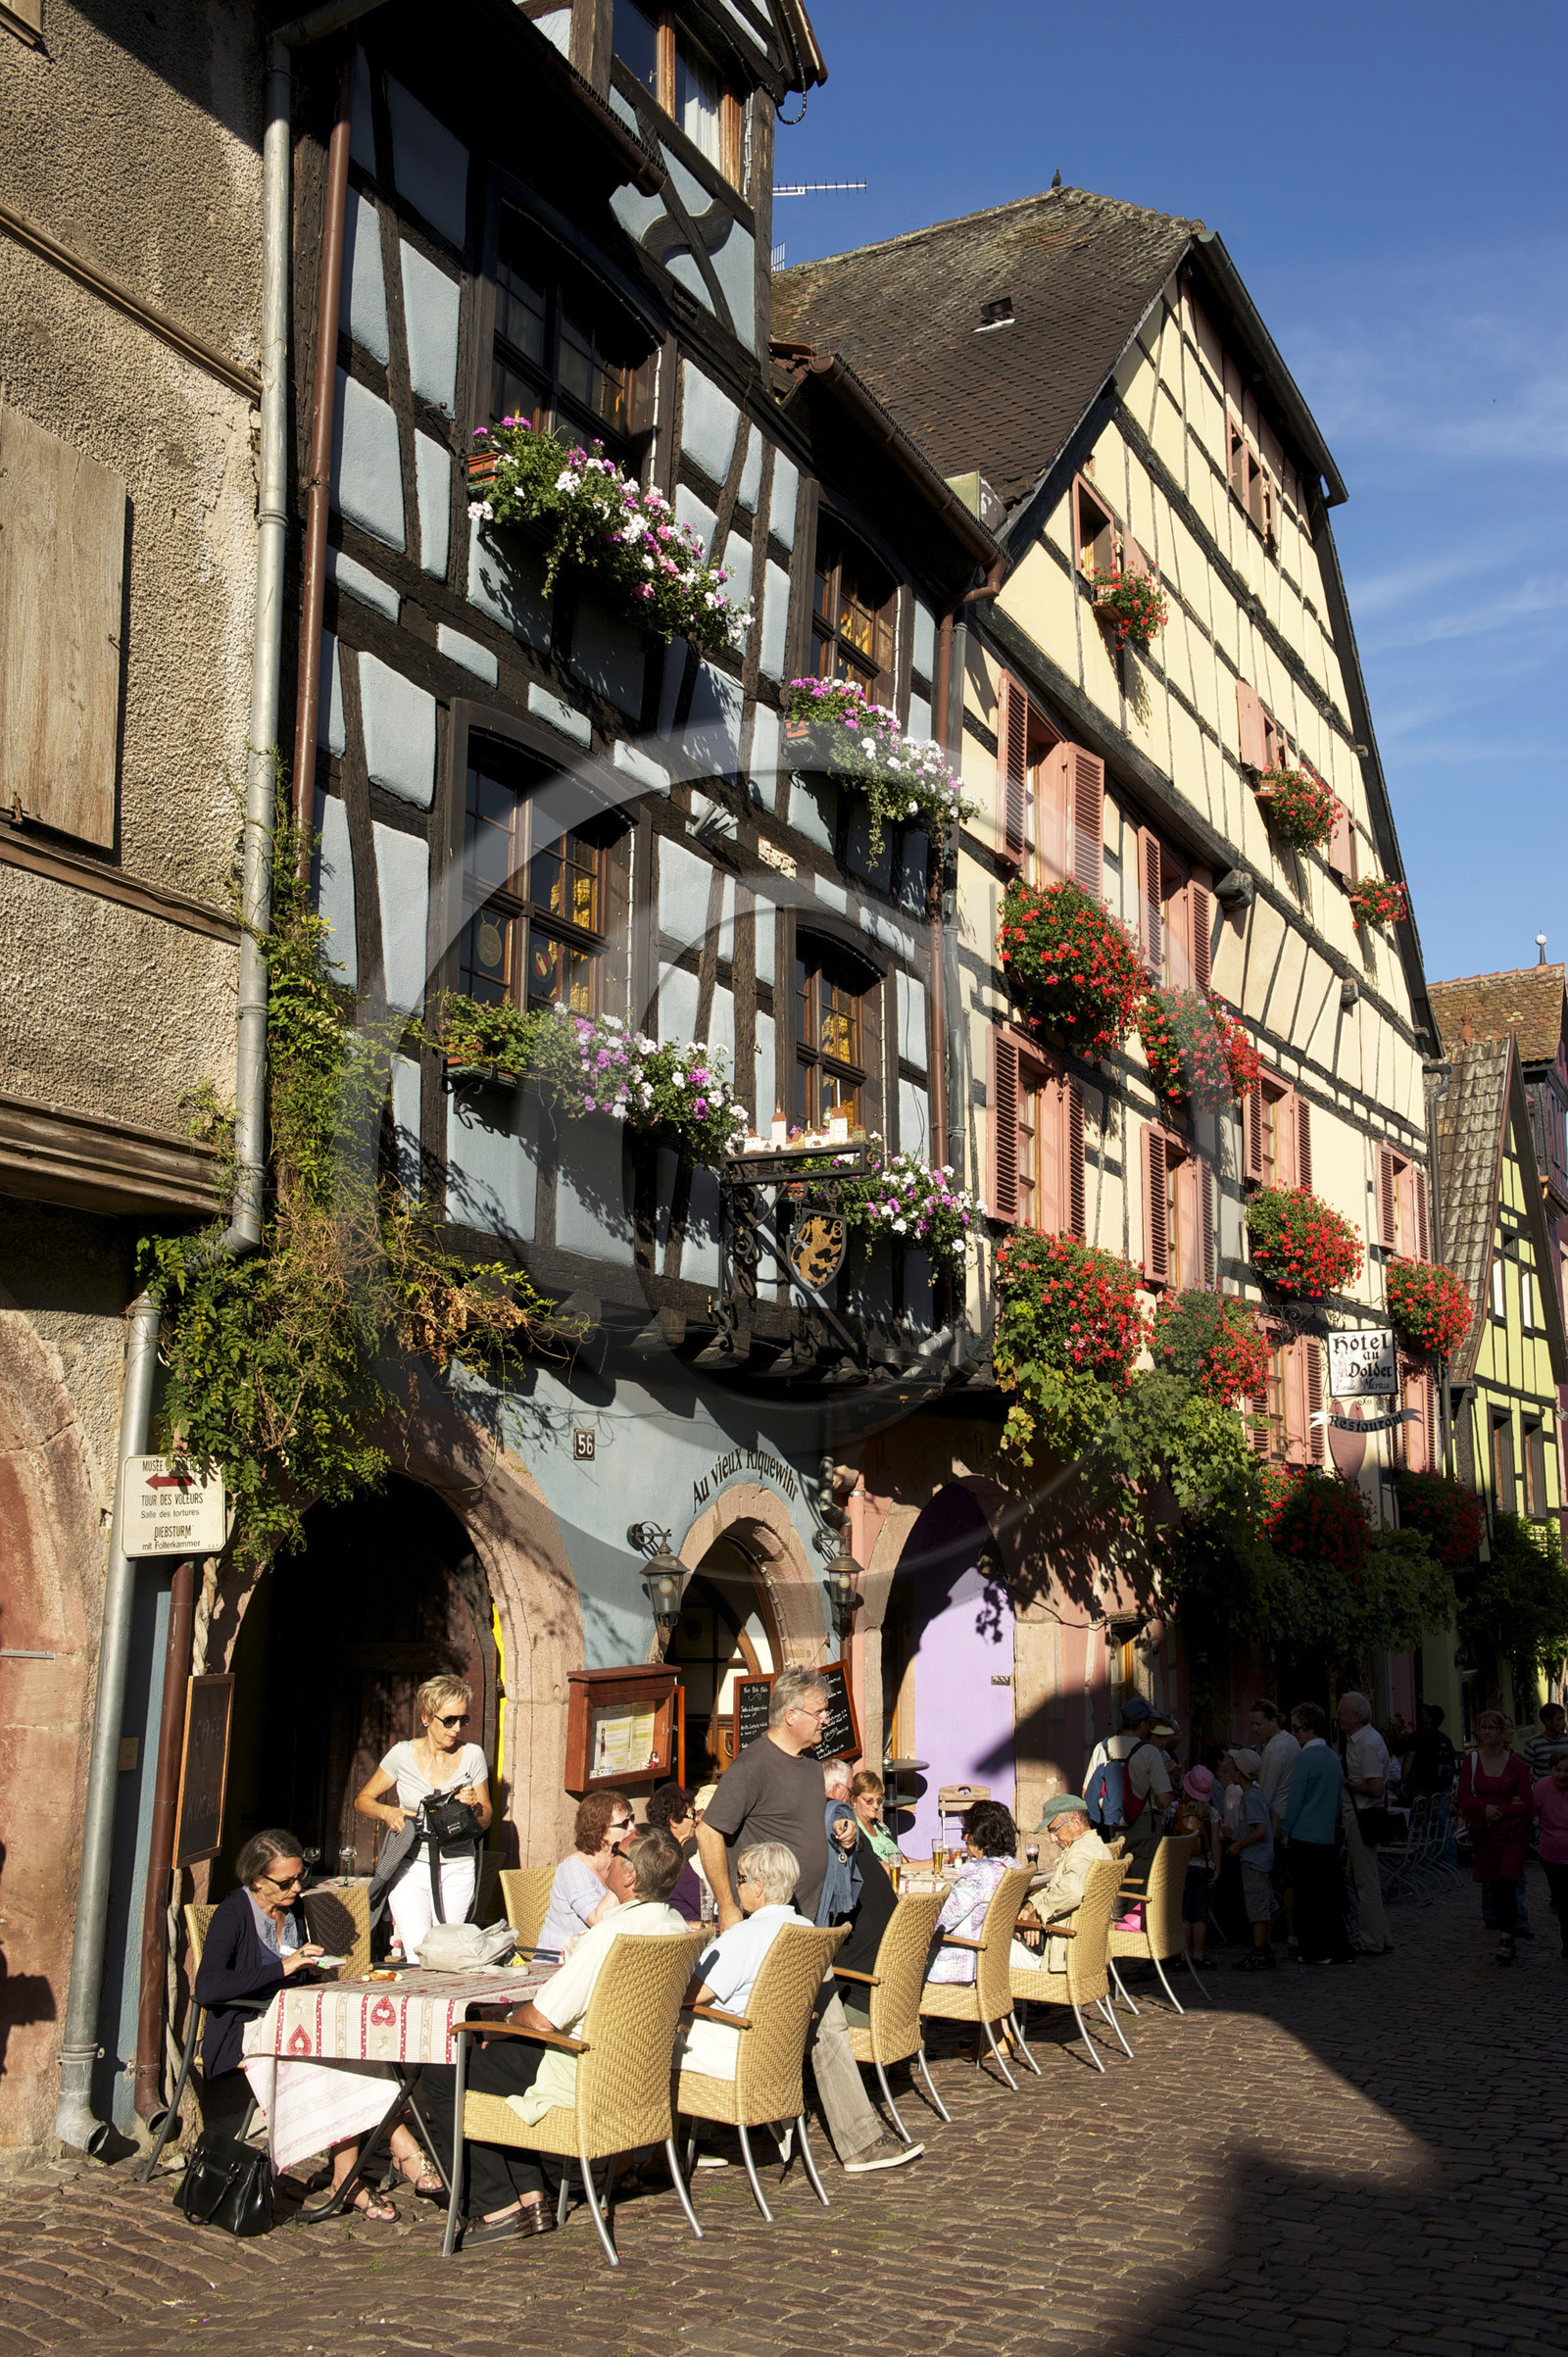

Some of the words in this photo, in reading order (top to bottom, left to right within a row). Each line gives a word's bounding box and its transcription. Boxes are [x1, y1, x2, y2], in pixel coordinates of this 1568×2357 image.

[1333, 1332, 1390, 1354] Hôtel
[1363, 1350, 1380, 1360] au
[1348, 1361, 1394, 1378] Dolder
[1329, 1413, 1404, 1432] Restaurant
[577, 1434, 594, 1455] 56
[693, 1476, 710, 1514] Au
[710, 1448, 743, 1488] vieux
[746, 1449, 799, 1502] Riquewihr
[141, 1495, 157, 1506] TOUR
[160, 1494, 172, 1505] DES
[175, 1493, 204, 1505] VOLEURS
[140, 1510, 157, 1519] Salle
[173, 1508, 200, 1517] tortures
[154, 1524, 192, 1539] DIEBSTURM
[154, 1540, 201, 1549] Folterkammer
